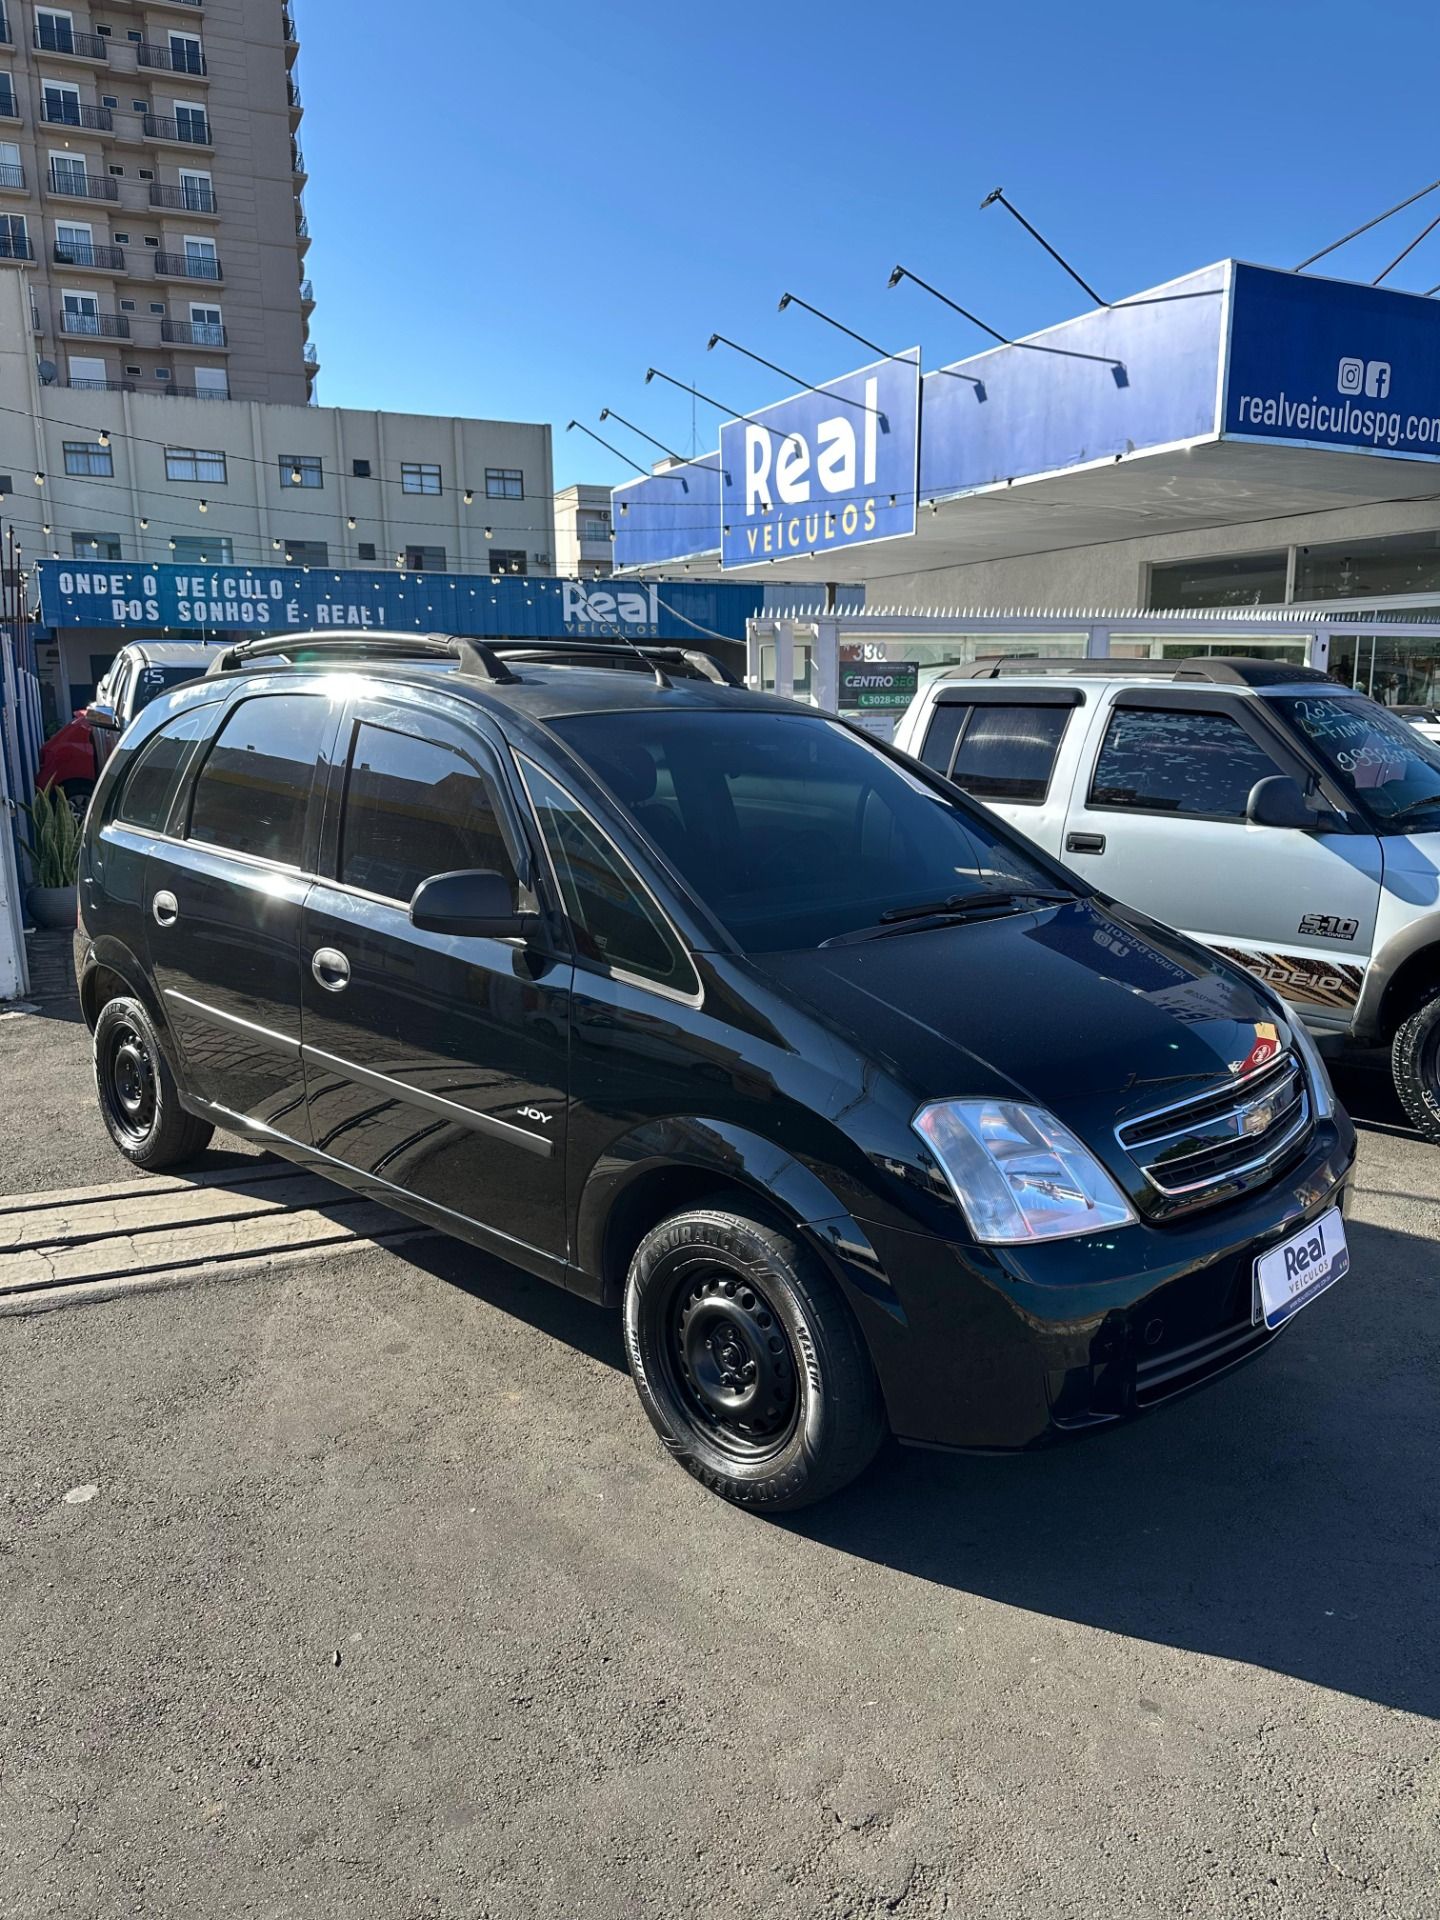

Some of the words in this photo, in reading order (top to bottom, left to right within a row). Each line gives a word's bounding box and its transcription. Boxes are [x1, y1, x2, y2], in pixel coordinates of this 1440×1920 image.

[745, 377, 877, 516] Real
[747, 498, 876, 554] VEÍCULOS
[59, 572, 125, 594] ONDE
[143, 574, 157, 596] O
[175, 572, 283, 600] VEÍCULO
[112, 599, 160, 621] DOS
[178, 600, 270, 623] SONHOS
[286, 598, 300, 623] É
[562, 581, 659, 624] Real
[565, 621, 657, 634] VEÍCULOS
[845, 675, 916, 688] CENTROSEG
[868, 695, 914, 705] 3028-820
[1294, 699, 1352, 721] 2011
[1301, 914, 1358, 935] S-10
[1246, 965, 1343, 991] ODEIO
[516, 1106, 553, 1124] JOY
[1283, 1224, 1326, 1281] Real
[1289, 1259, 1329, 1294] VEÍCULOS
